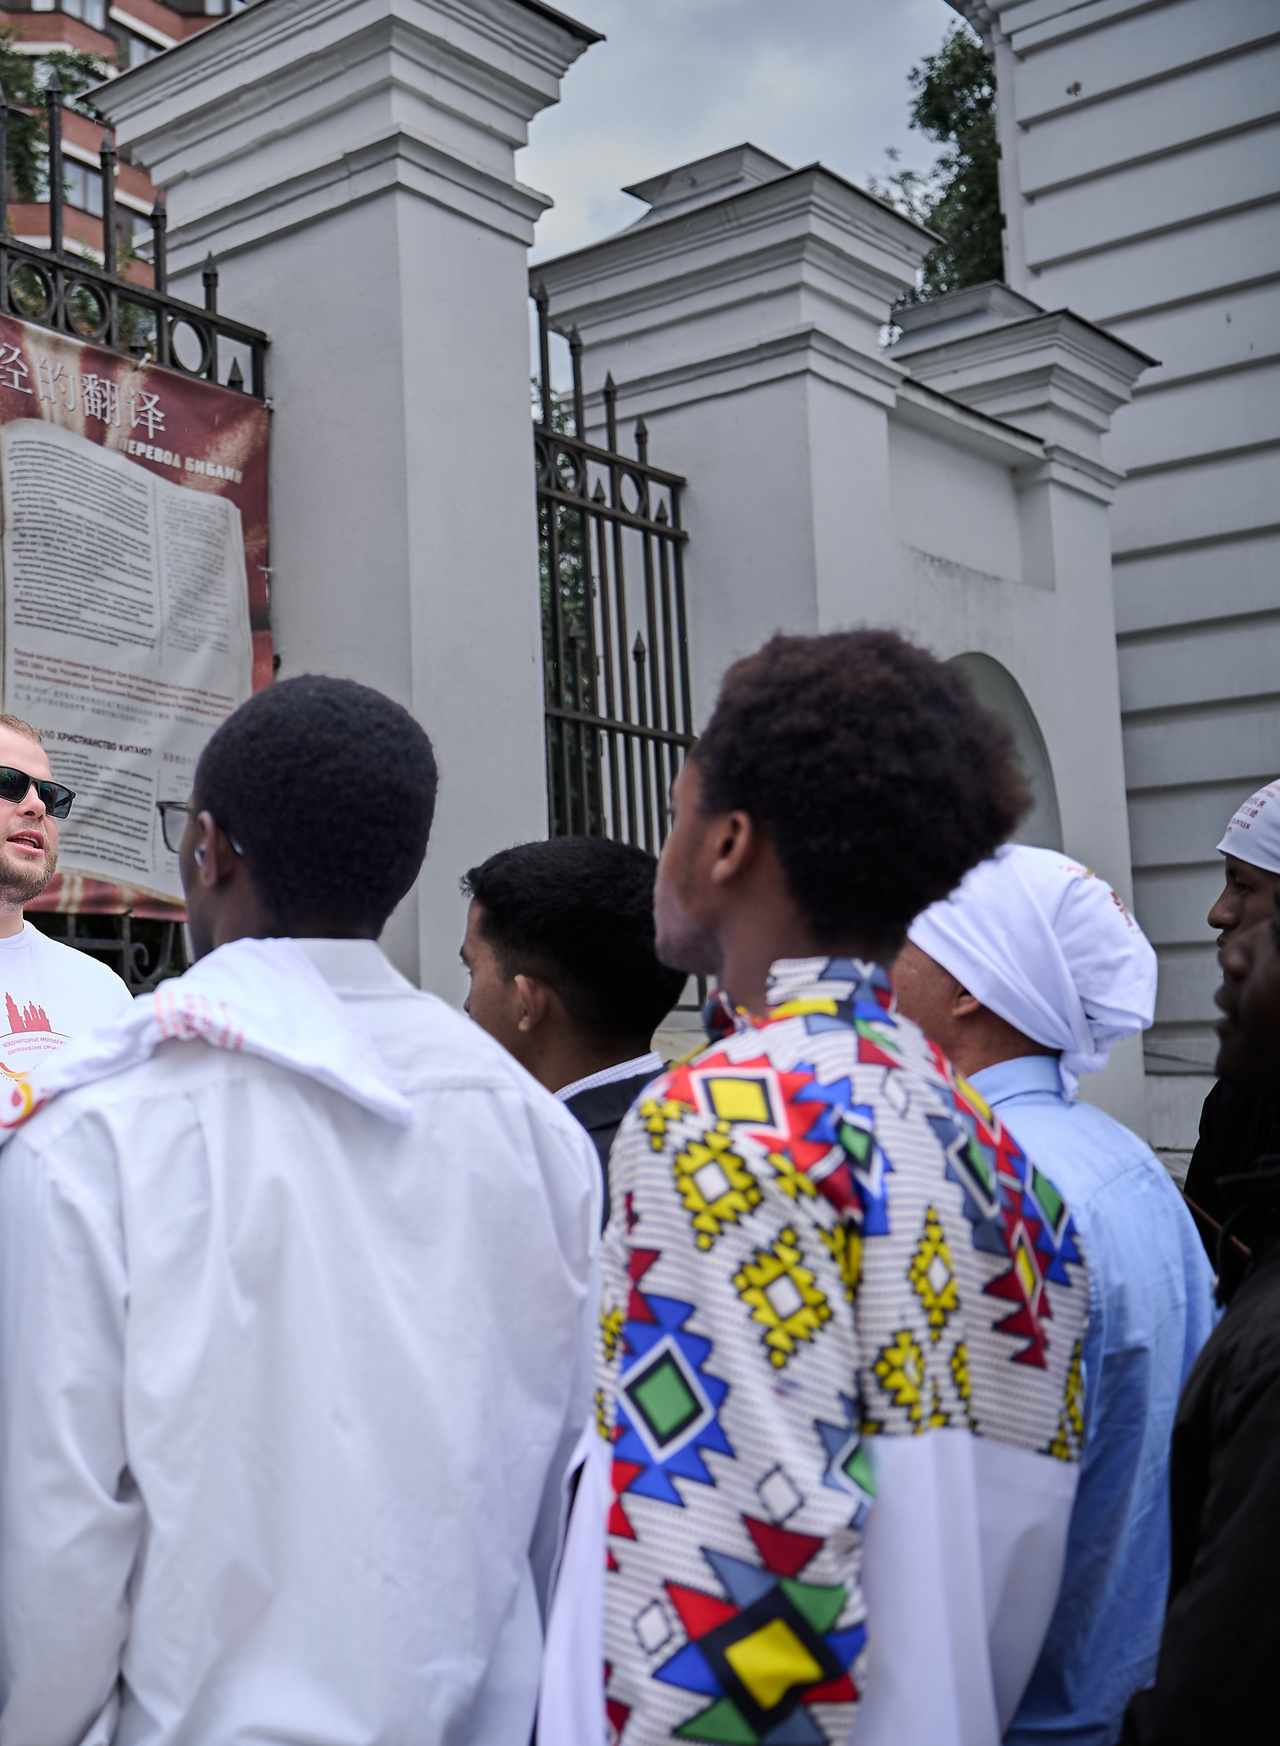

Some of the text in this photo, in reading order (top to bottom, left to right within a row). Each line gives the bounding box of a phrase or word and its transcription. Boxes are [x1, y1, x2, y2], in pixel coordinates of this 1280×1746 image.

[117, 436, 243, 485] ПЕРЕВОД БИБЛИИ
[57, 732, 117, 751] ХРИСТИАНСТВО
[2, 1037, 39, 1048] МЕЖДУНАРОДНЫЕ
